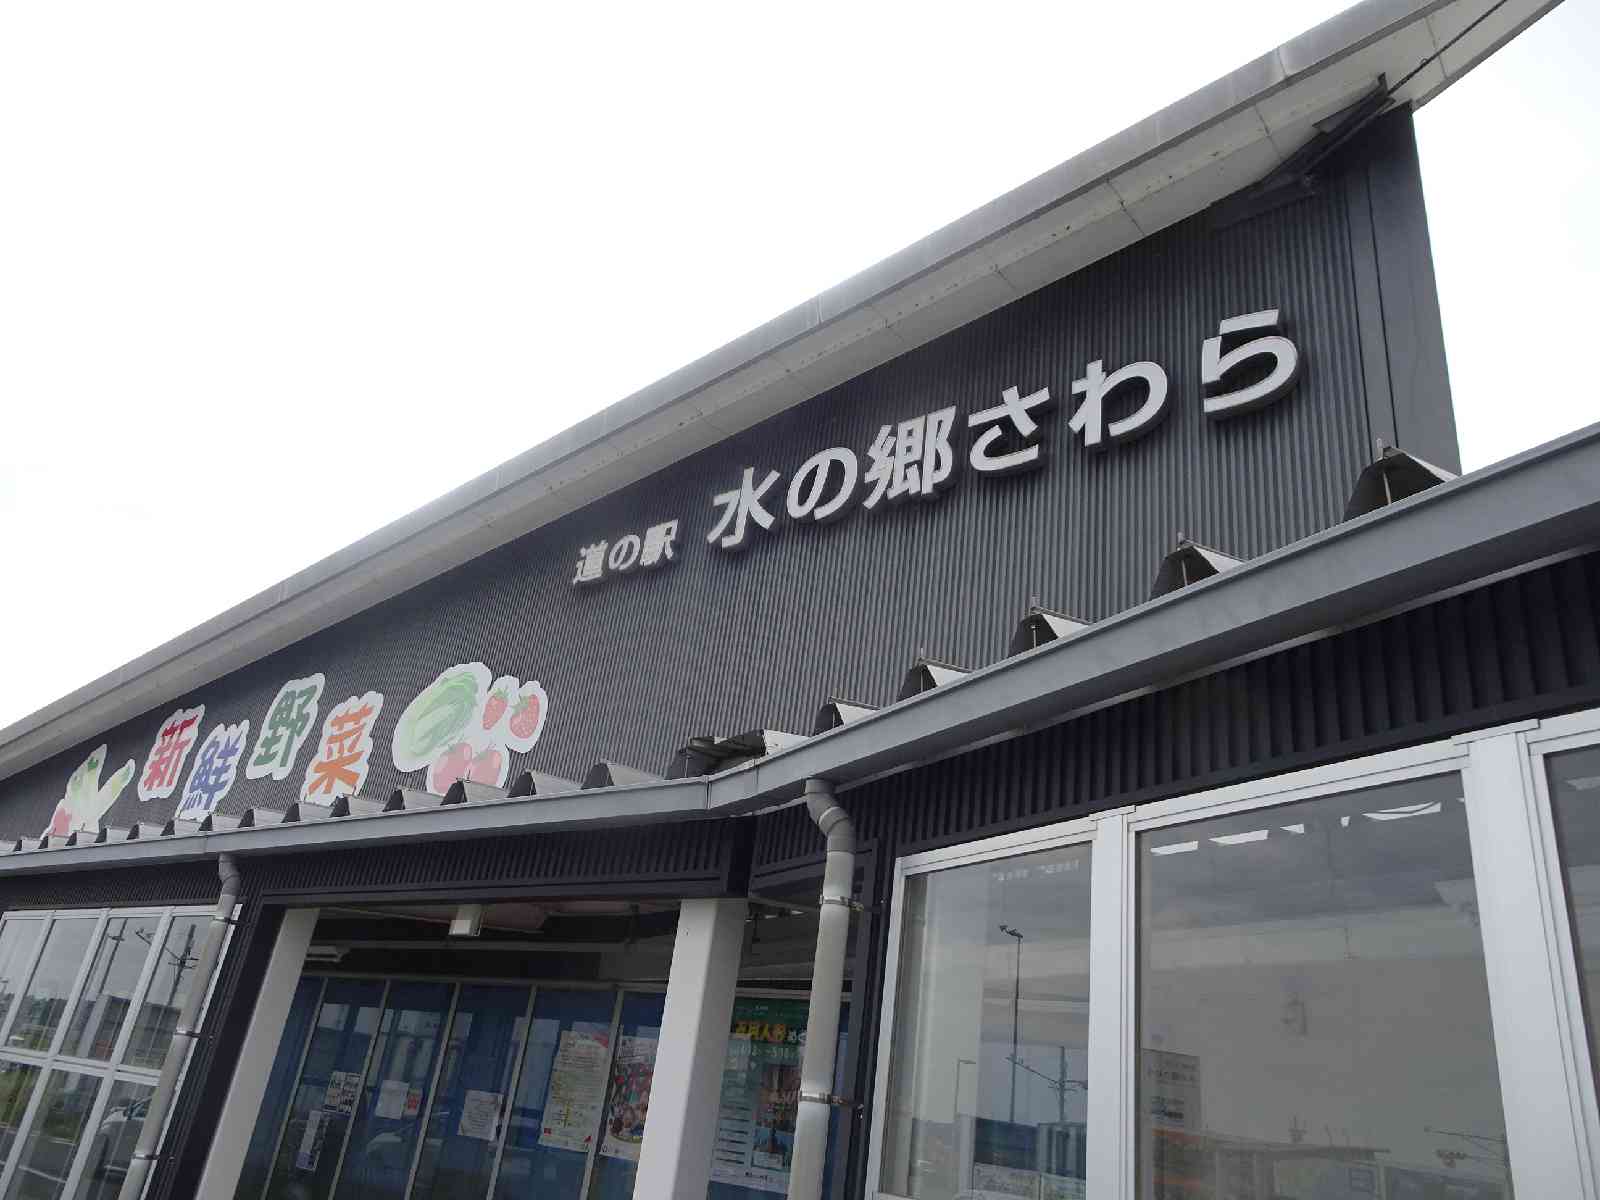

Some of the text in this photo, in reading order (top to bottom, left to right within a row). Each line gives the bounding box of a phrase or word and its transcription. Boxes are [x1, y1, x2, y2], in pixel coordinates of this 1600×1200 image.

[574, 308, 1301, 585] 道の駅 水の郷さわら
[145, 684, 374, 809] 新鮮野菜
